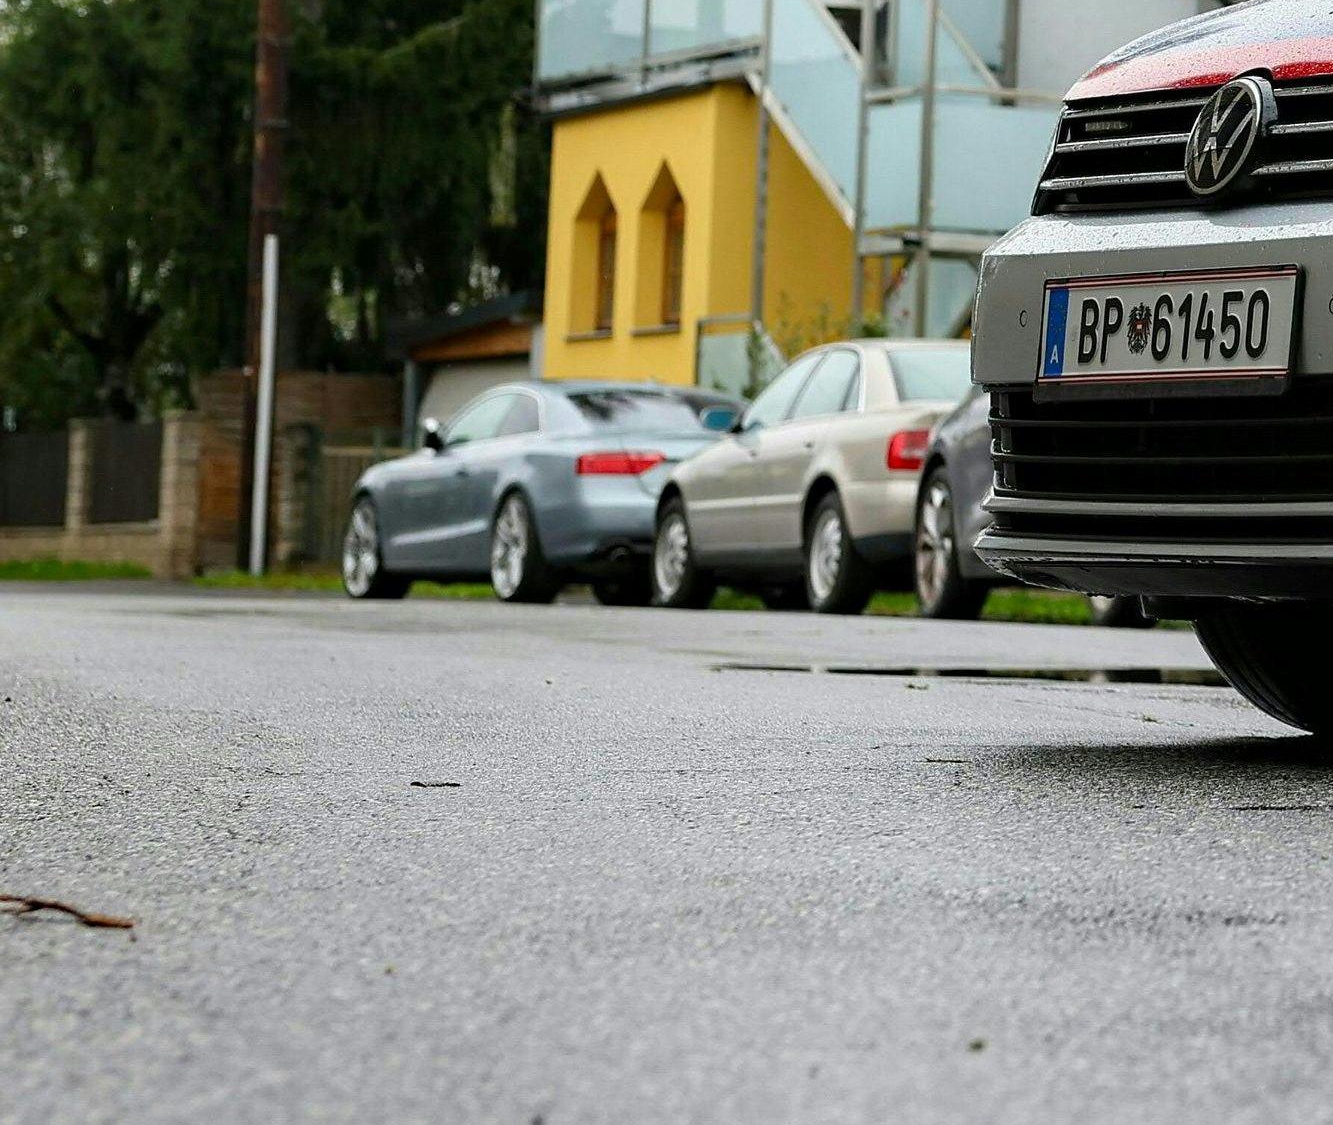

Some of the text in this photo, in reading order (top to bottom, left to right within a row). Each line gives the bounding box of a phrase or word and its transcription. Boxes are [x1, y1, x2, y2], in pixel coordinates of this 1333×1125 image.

[1190, 83, 1258, 183] VW
[1050, 344, 1059, 364] A
[1077, 288, 1271, 364] BP 61450
